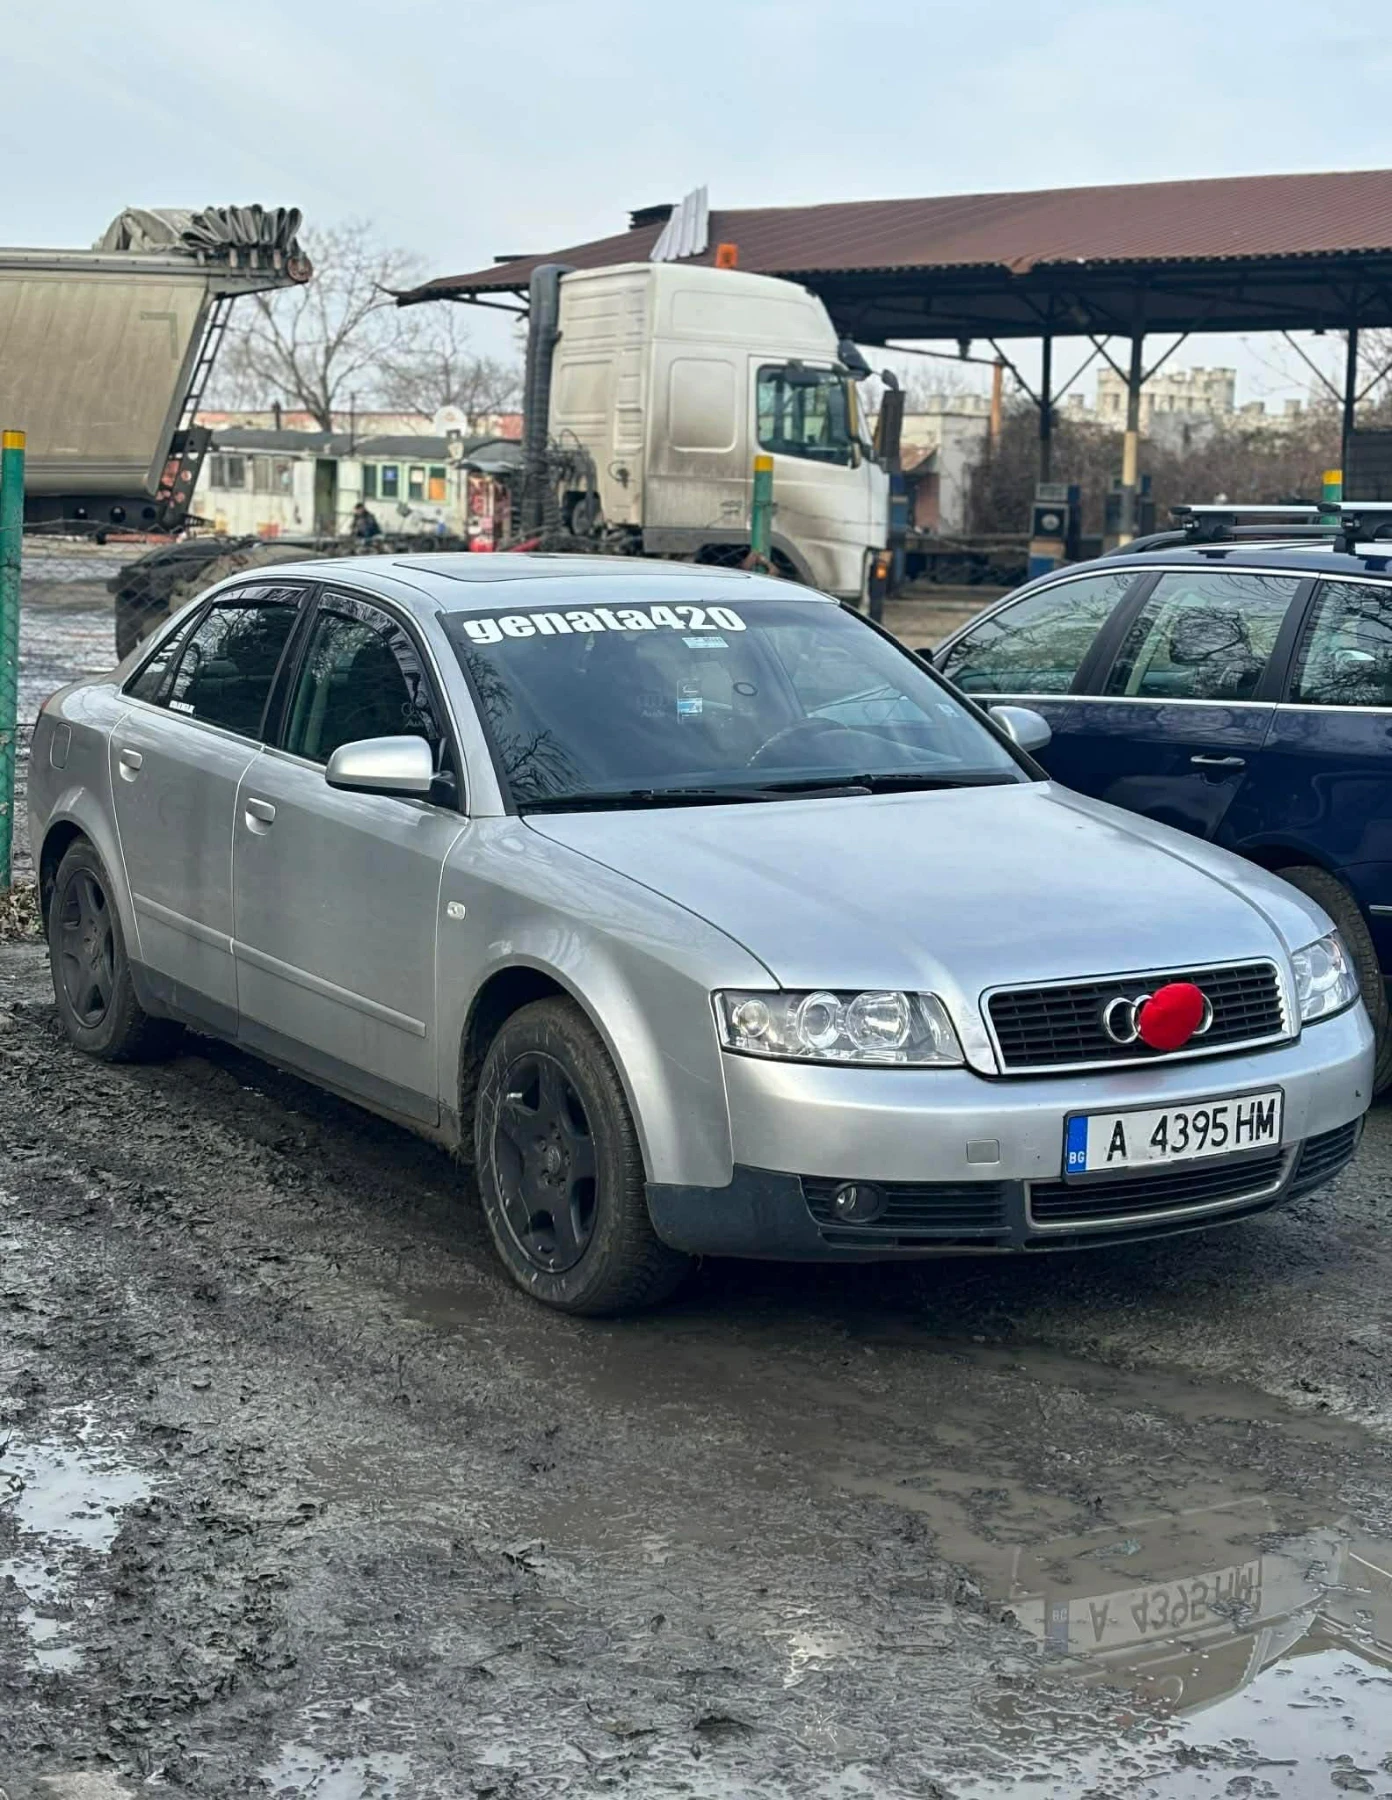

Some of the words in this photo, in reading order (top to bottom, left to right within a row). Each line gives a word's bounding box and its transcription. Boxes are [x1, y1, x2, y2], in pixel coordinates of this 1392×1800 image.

[463, 605, 747, 644] genata420
[1106, 1119, 1127, 1162] A
[1150, 1106, 1229, 1155] 4395
[1235, 1098, 1276, 1144] HM
[1069, 1151, 1085, 1164] BG
